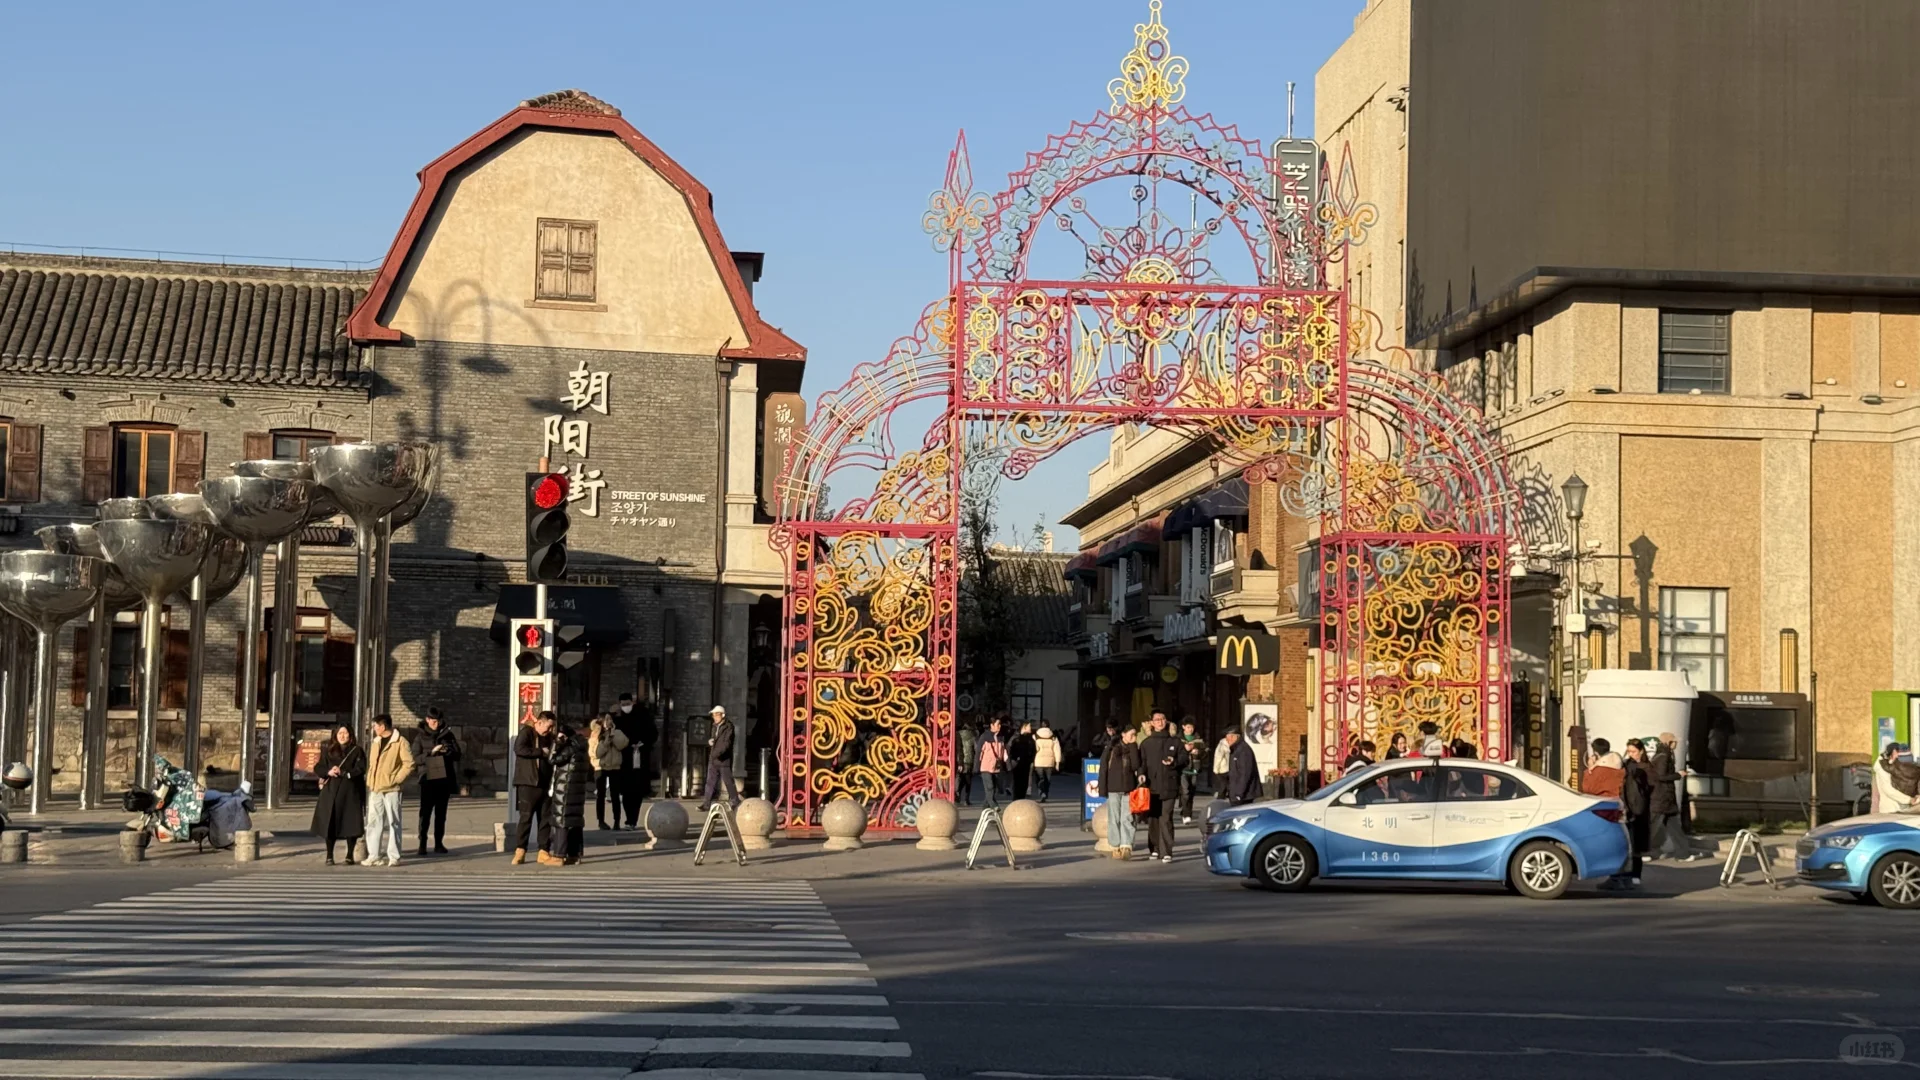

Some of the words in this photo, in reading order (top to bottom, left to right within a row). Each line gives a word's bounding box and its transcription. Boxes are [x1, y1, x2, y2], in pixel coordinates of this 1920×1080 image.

[611, 491, 646, 500] STREET
[646, 492, 659, 501] OF
[660, 492, 706, 503] SUNSHINE
[611, 502, 649, 515] 조양가
[610, 516, 676, 528] チャオヤン通り
[520, 683, 541, 724] 行人
[1362, 851, 1400, 862] 1360
